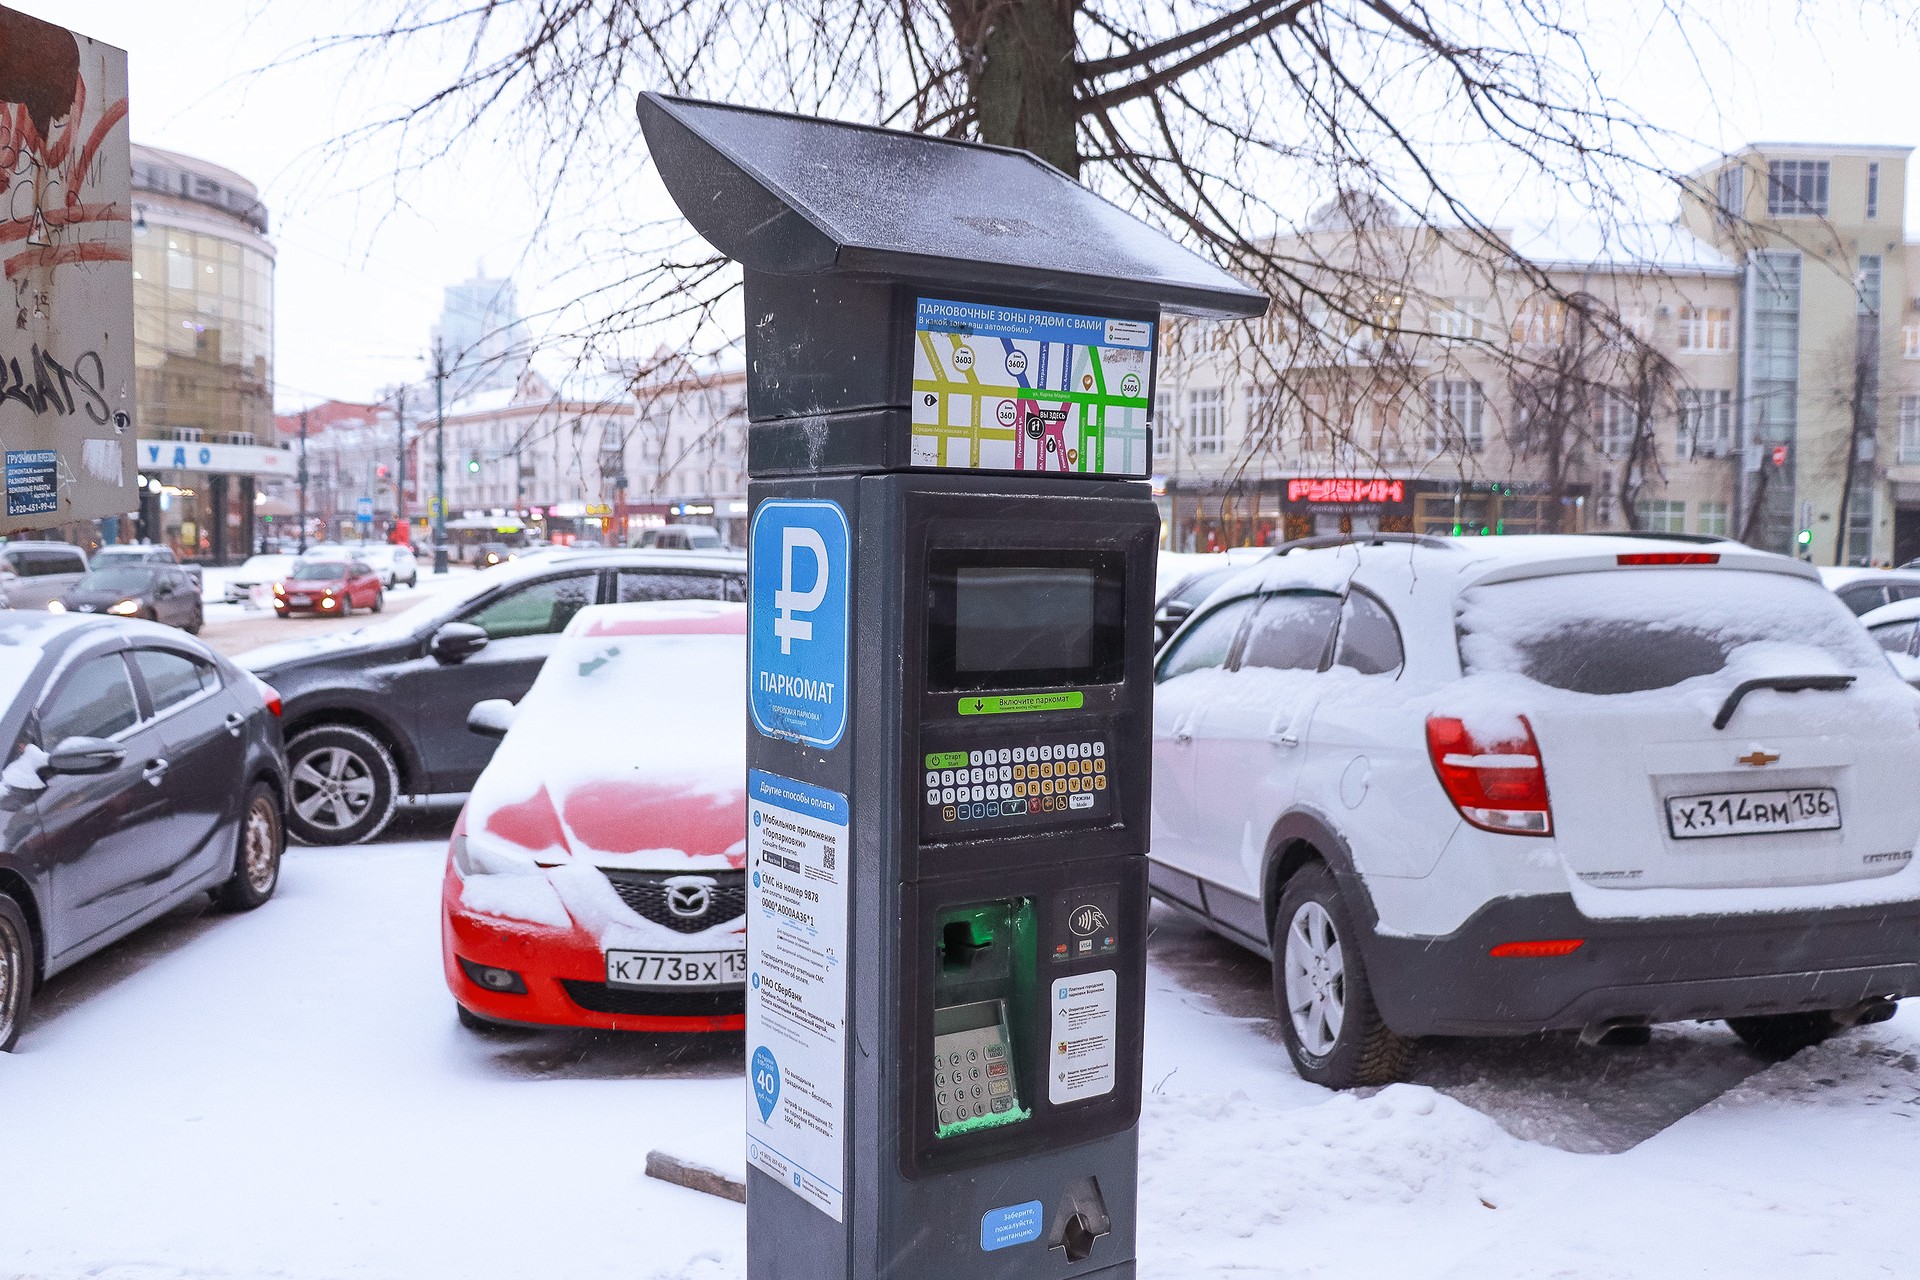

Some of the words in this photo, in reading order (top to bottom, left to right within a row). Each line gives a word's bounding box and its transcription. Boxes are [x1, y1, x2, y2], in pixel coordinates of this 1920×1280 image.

[919, 304, 996, 320] ПАРКОВОЧНЫЕ
[998, 311, 1026, 324] ЗОНЫ
[1029, 315, 1064, 327] РЯДОМ
[1066, 318, 1073, 328] С
[1074, 319, 1102, 331] ВАМИ
[925, 318, 948, 326] какой
[984, 323, 1033, 334] автомобиль?
[955, 356, 972, 365] 3603
[1008, 360, 1025, 368] 3602
[1123, 384, 1138, 392] 3605
[1040, 411, 1048, 419] ВЫ
[760, 671, 835, 704] ПАРКОМАТ
[999, 698, 1034, 706] Включите
[1035, 696, 1069, 705] паркомат
[974, 754, 979, 762] 0
[1002, 752, 1007, 760] 2
[1016, 751, 1021, 759] 3
[1030, 750, 1035, 758] 4
[1044, 749, 1049, 757] 5
[1057, 748, 1062, 756] 6
[1070, 747, 1075, 755] 7
[1083, 746, 1088, 754] 8
[1096, 745, 1101, 753] 9
[1016, 768, 1022, 776] D
[1030, 767, 1035, 775] F
[1044, 766, 1050, 774] G
[1071, 764, 1076, 772] J
[1084, 763, 1089, 771] L
[1096, 762, 1103, 770] N
[1017, 785, 1023, 793] Q
[1031, 784, 1037, 792] R
[1045, 783, 1051, 791] S
[1058, 782, 1064, 790] U
[1071, 781, 1077, 789] V
[1084, 780, 1091, 788] W
[1098, 778, 1103, 786] Z
[760, 781, 782, 796] Другие
[783, 790, 810, 804] способы
[811, 798, 835, 811] оплаты
[1792, 792, 1830, 816] 136
[762, 813, 796, 832] Мобильное
[797, 825, 836, 844] приложение
[762, 827, 807, 848] «Горпарковки»
[762, 873, 775, 886] СМС
[775, 881, 783, 889] на
[784, 883, 803, 898] номер
[804, 889, 819, 903] 9878
[616, 957, 717, 981] К773ВХ
[761, 975, 773, 989] ПАО
[774, 981, 802, 1003] Сбербанк
[954, 1055, 959, 1064] 2
[970, 1052, 976, 1061] 3
[757, 1069, 774, 1095] 40
[940, 1076, 945, 1084] 4
[956, 1073, 962, 1082] 5
[973, 1069, 978, 1078] 6
[942, 1094, 946, 1102] 7
[959, 1091, 964, 1099] 8
[975, 1087, 981, 1096] 9
[960, 1108, 967, 1117] 0
[1003, 1208, 1035, 1221] Заберите,
[995, 1219, 1035, 1233] пожалуйста,
[996, 1229, 1035, 1243] квитанцию.
